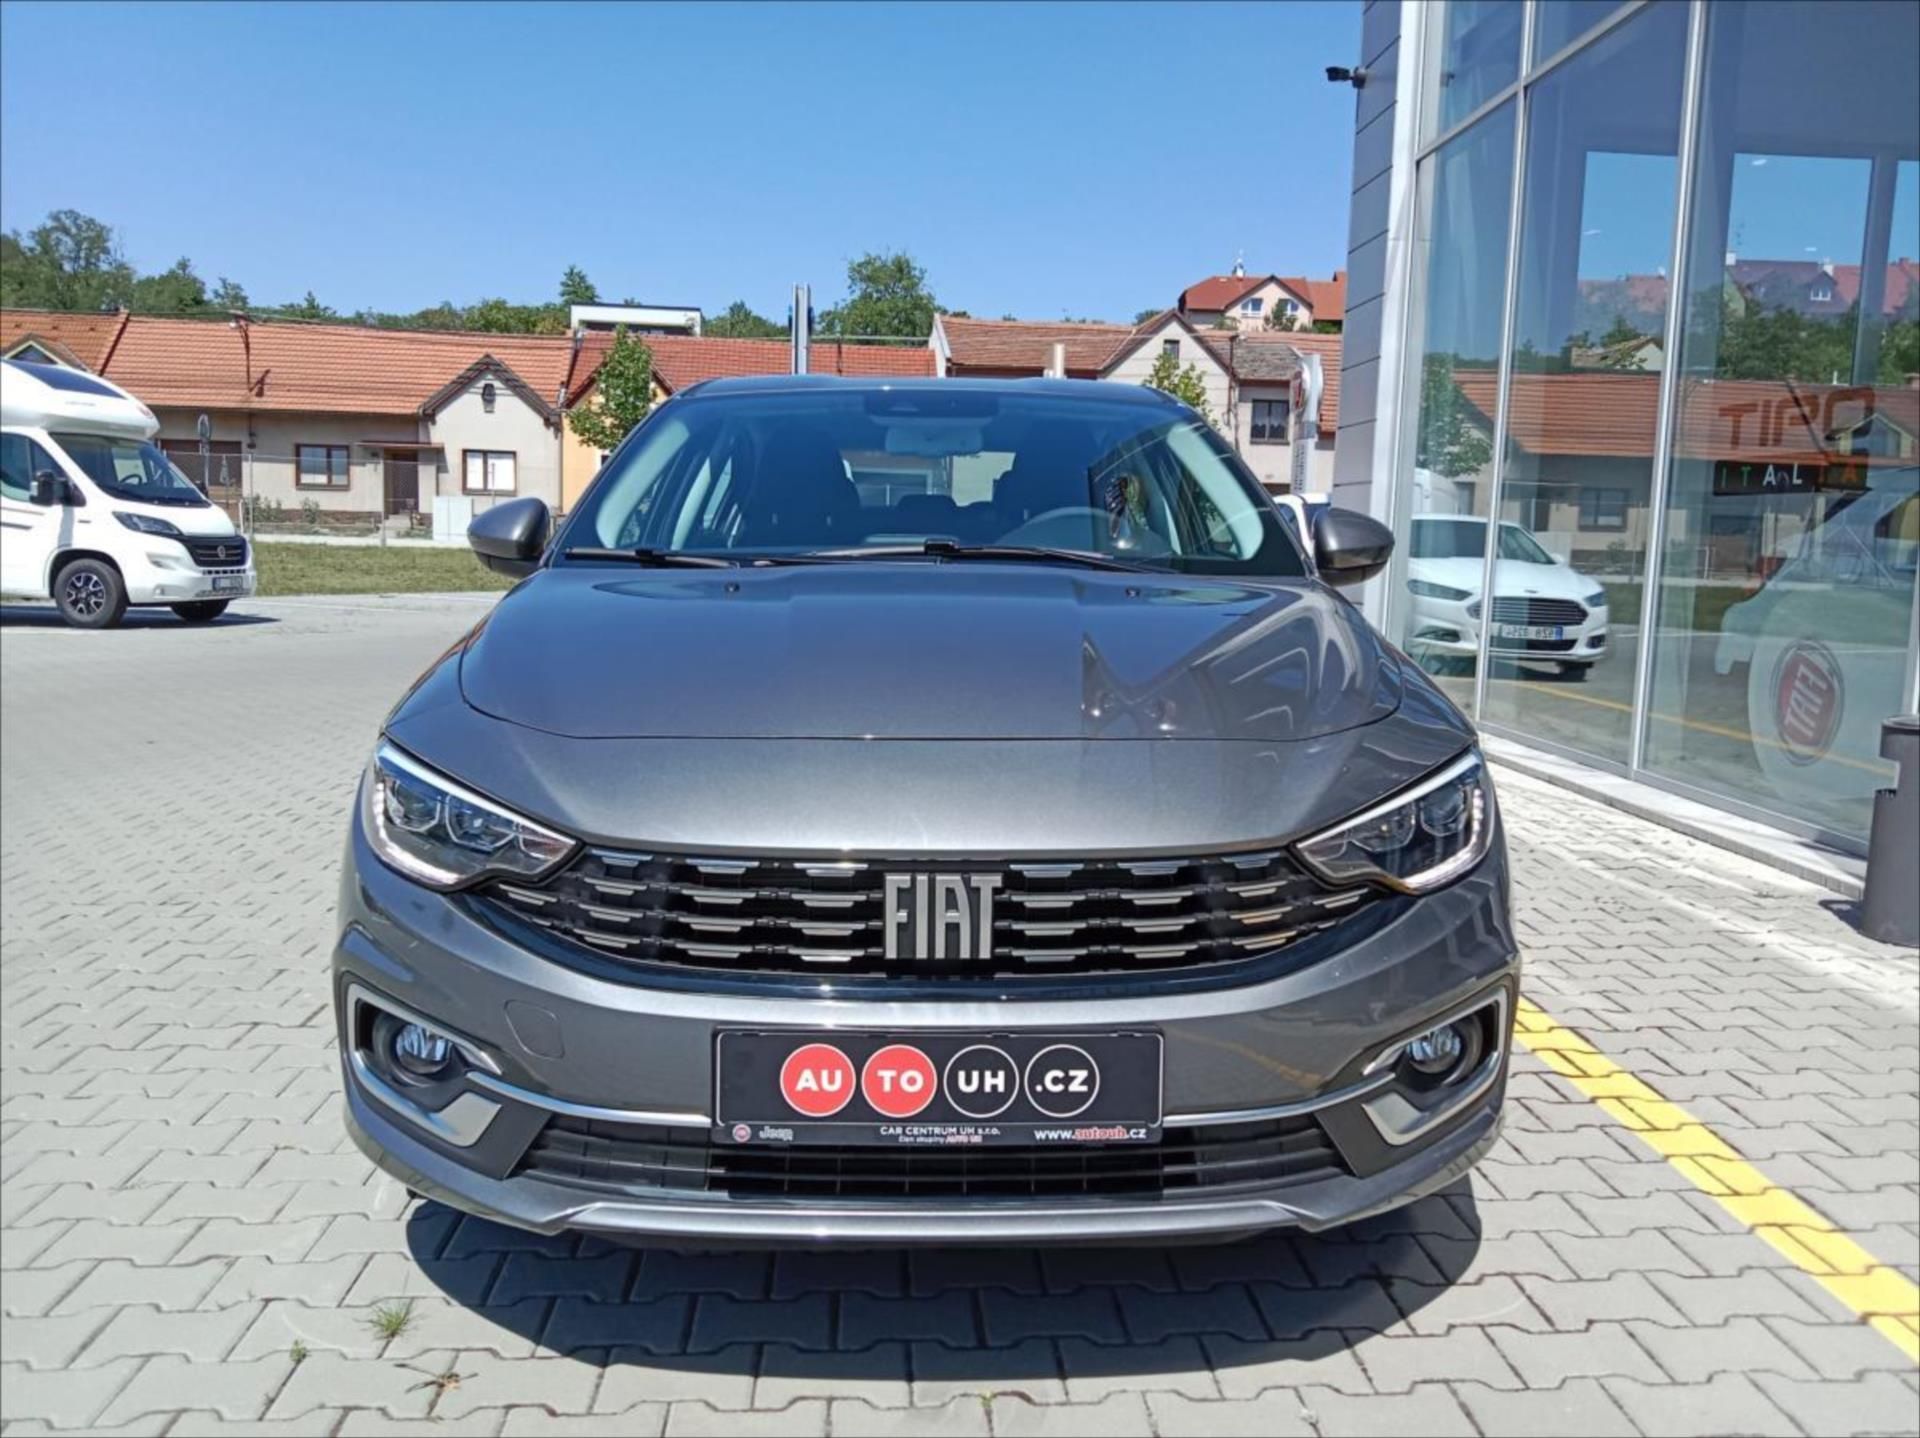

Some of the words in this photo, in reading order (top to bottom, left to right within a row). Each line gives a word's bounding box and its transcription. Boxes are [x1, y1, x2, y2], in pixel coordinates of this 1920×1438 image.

[884, 872, 1003, 960] FIAT
[957, 1070, 1006, 1093] UH
[880, 1126, 902, 1135] CAR
[905, 1126, 957, 1135] CENTRUM
[959, 1126, 975, 1135] UH
[1033, 1125, 1147, 1140] www.autouh.cz
